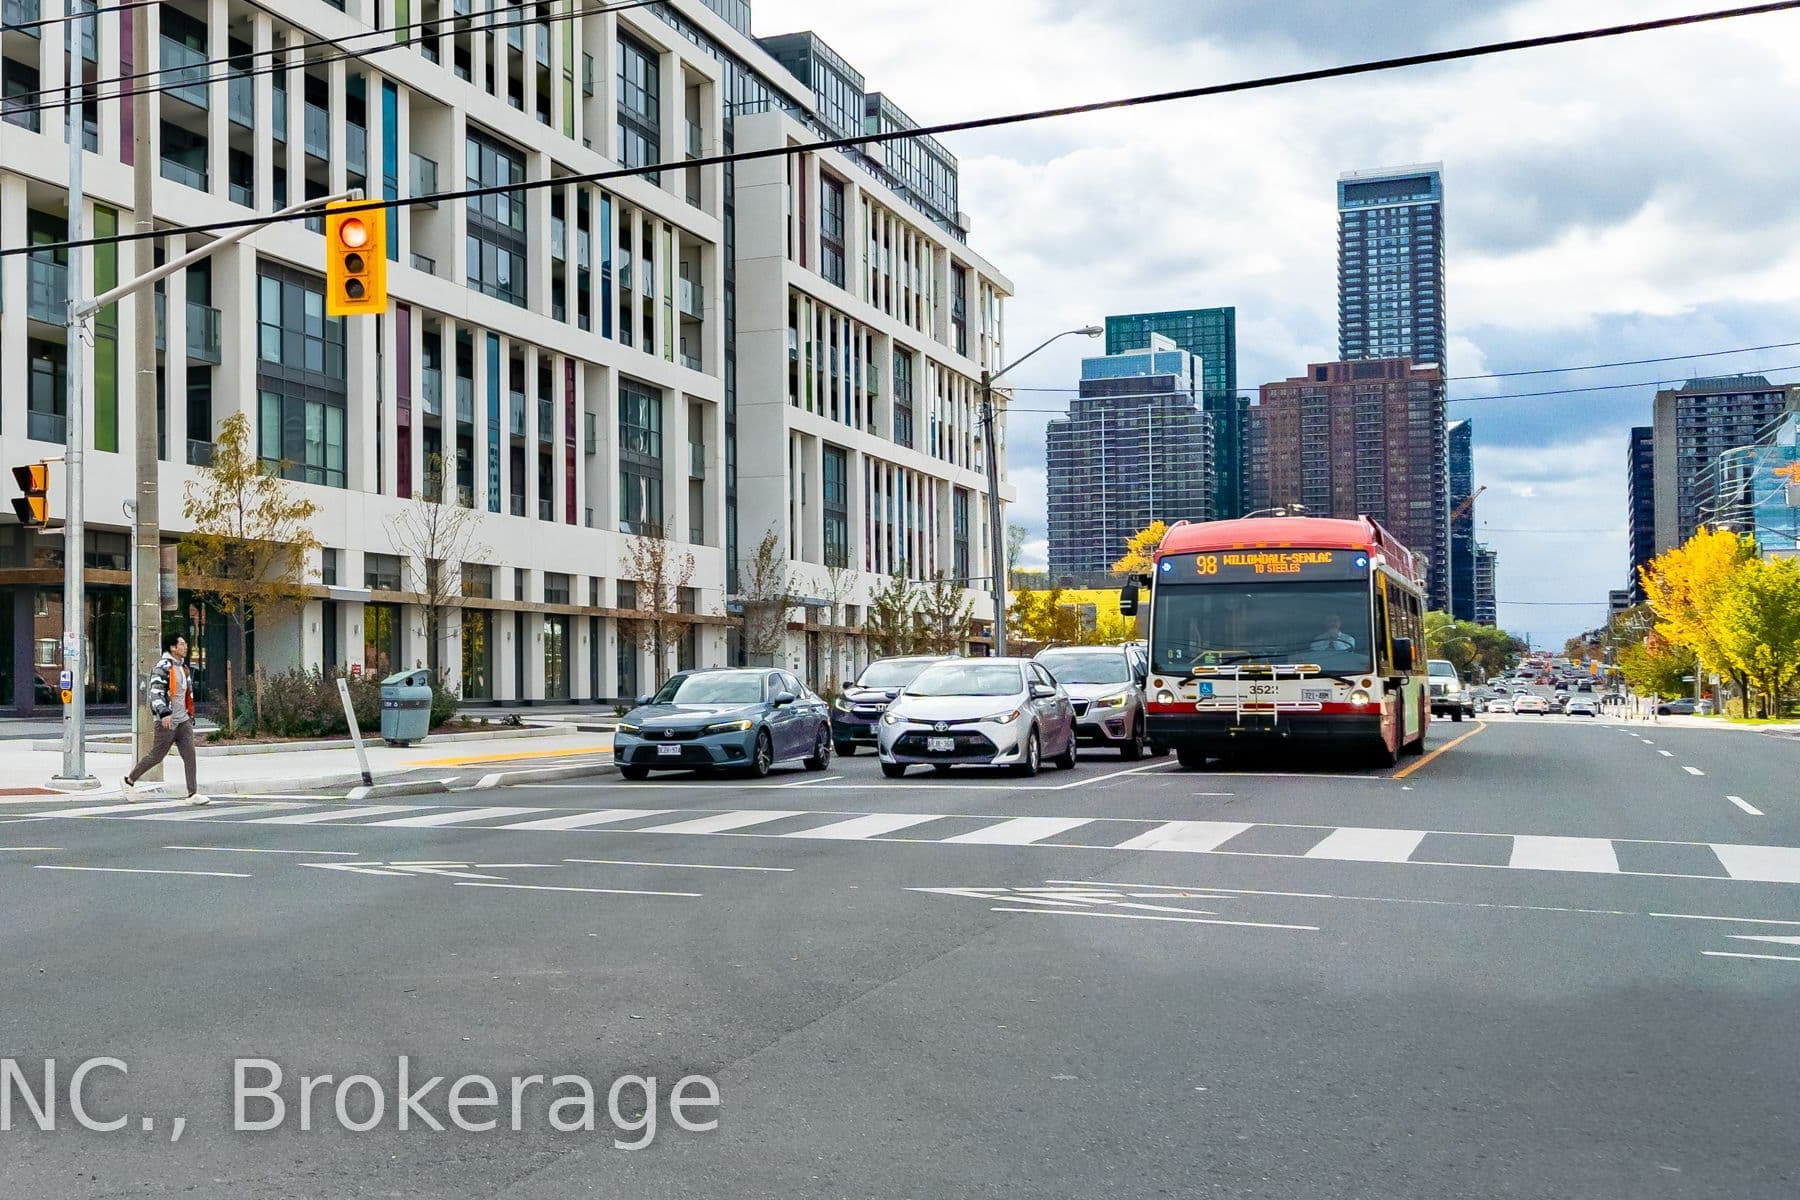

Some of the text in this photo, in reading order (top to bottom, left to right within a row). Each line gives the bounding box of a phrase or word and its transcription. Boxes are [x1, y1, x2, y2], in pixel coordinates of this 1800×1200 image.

[1196, 555, 1218, 575] 98
[1255, 563, 1301, 573] TO STEELES
